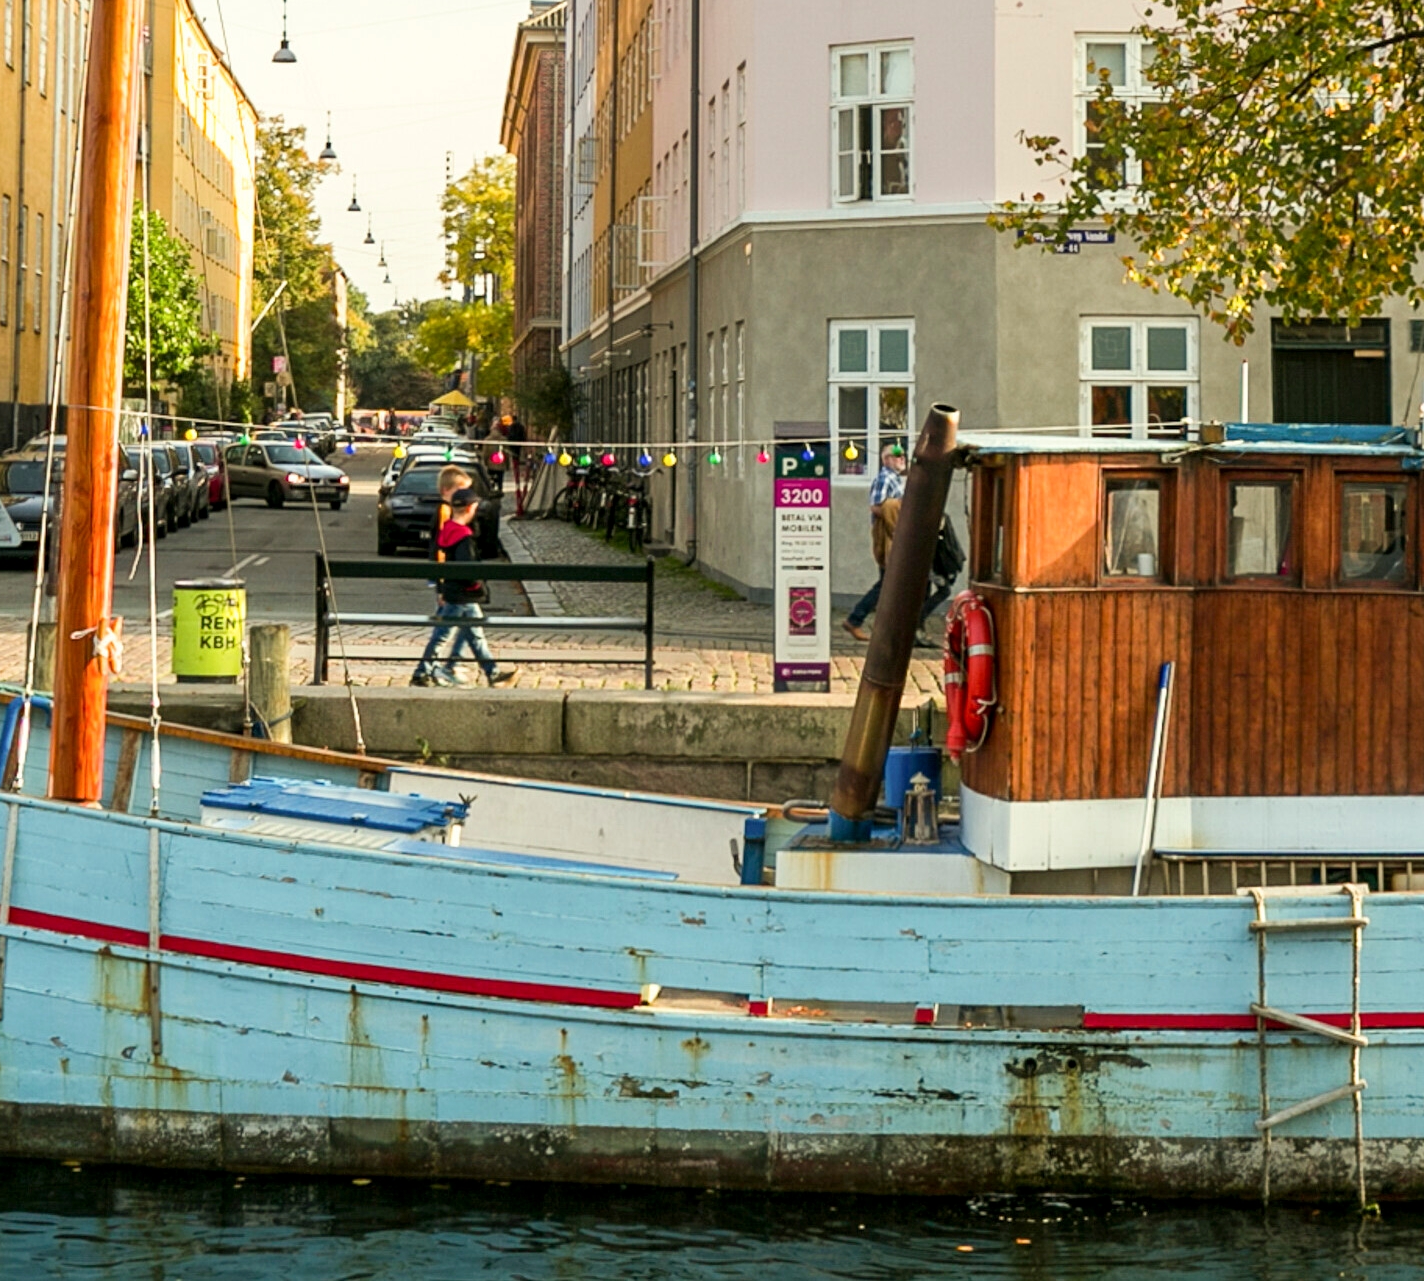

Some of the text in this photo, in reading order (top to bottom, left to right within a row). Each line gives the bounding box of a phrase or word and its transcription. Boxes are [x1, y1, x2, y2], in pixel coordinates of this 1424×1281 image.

[781, 457, 798, 476] P
[780, 488, 823, 504] 3200
[781, 514, 822, 522] BETAL VIA
[781, 524, 822, 532] MOBILEN
[201, 616, 236, 630] REN
[200, 636, 235, 649] KBH
